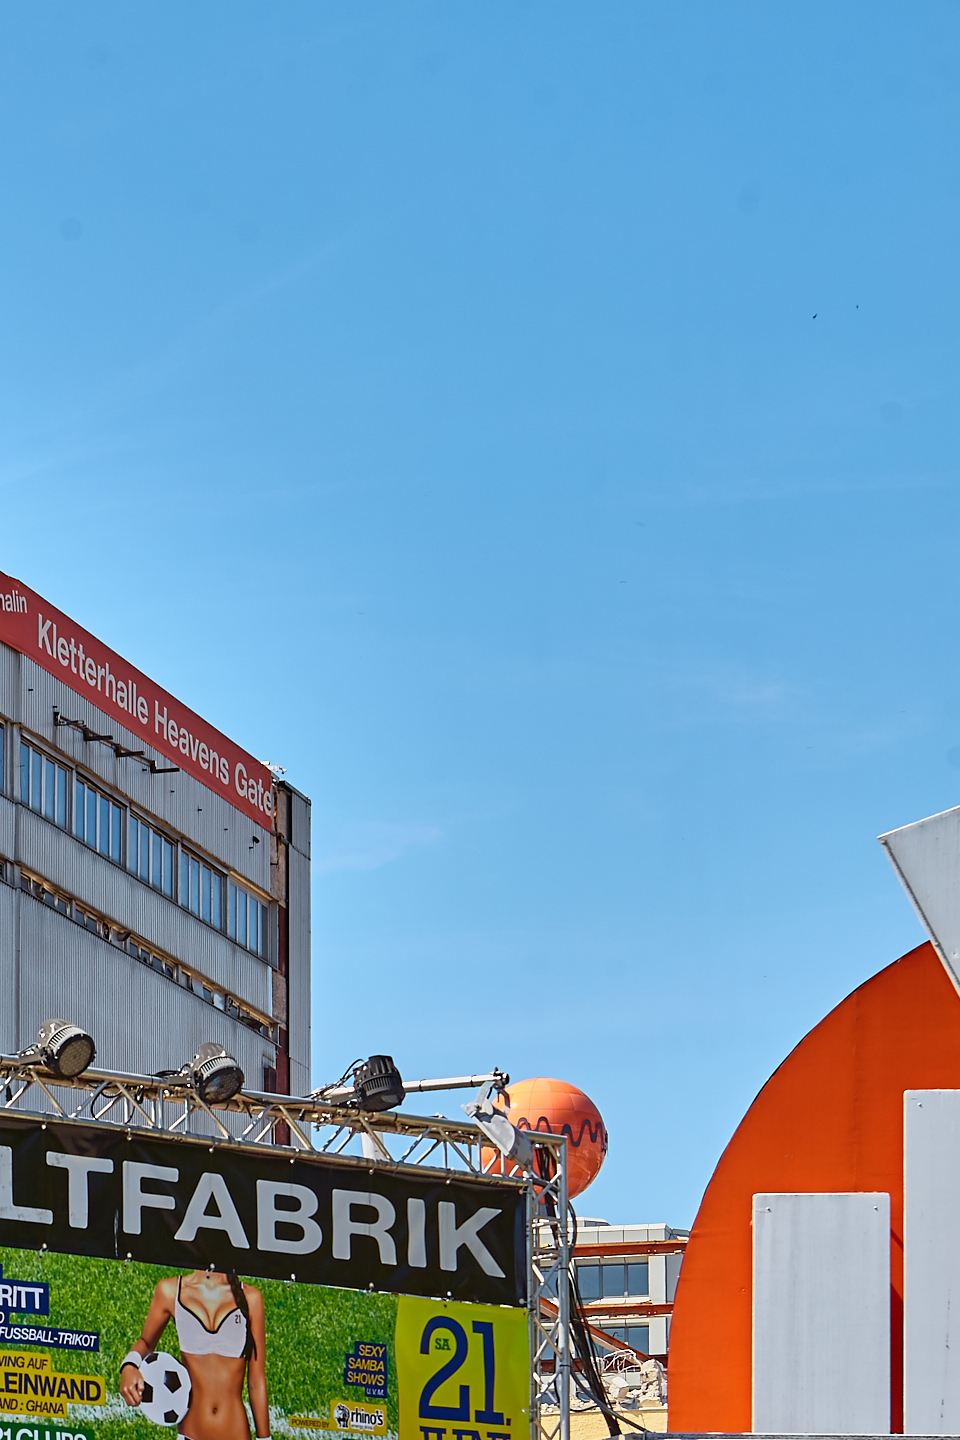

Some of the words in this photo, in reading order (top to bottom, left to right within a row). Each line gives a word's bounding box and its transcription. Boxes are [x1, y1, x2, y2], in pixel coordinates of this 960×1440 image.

[37, 613, 149, 726] Kletterhalle
[154, 698, 230, 786] Heavens
[235, 1314, 242, 1324] 21
[358, 1344, 386, 1358] SEXY
[434, 1338, 451, 1351] SA
[26, 1357, 49, 1370] AUF
[348, 1357, 385, 1372] SAMBA
[419, 1315, 512, 1426] 21.
[346, 1371, 385, 1386] SHOWS
[26, 1400, 65, 1415] GHANA
[291, 1418, 321, 1428] POWERED
[321, 1420, 330, 1429] BY
[351, 1406, 384, 1426] rhino's
